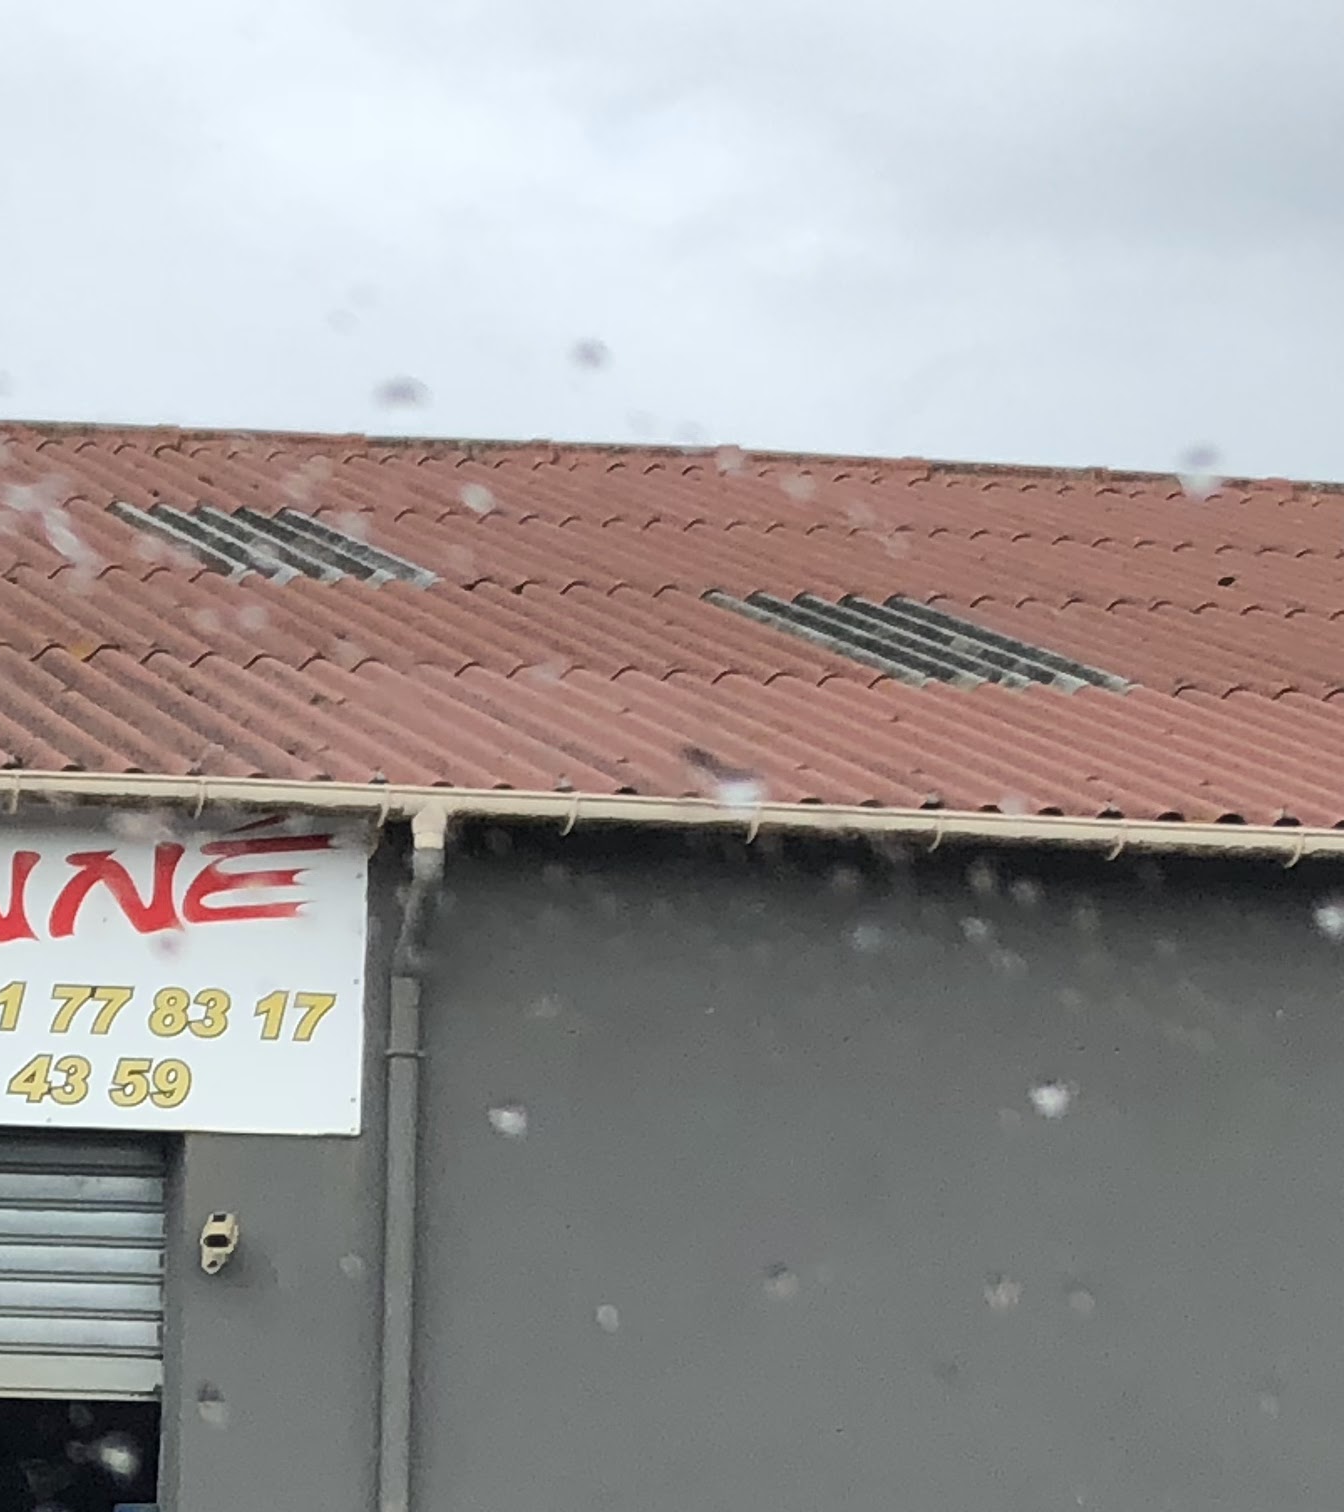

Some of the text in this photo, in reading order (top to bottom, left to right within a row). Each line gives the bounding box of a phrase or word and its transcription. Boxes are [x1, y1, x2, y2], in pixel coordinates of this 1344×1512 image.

[50, 984, 135, 1035] 77
[149, 986, 231, 1038] 83
[254, 990, 338, 1042] 17
[7, 1053, 92, 1105] 43
[109, 1057, 193, 1109] 59
